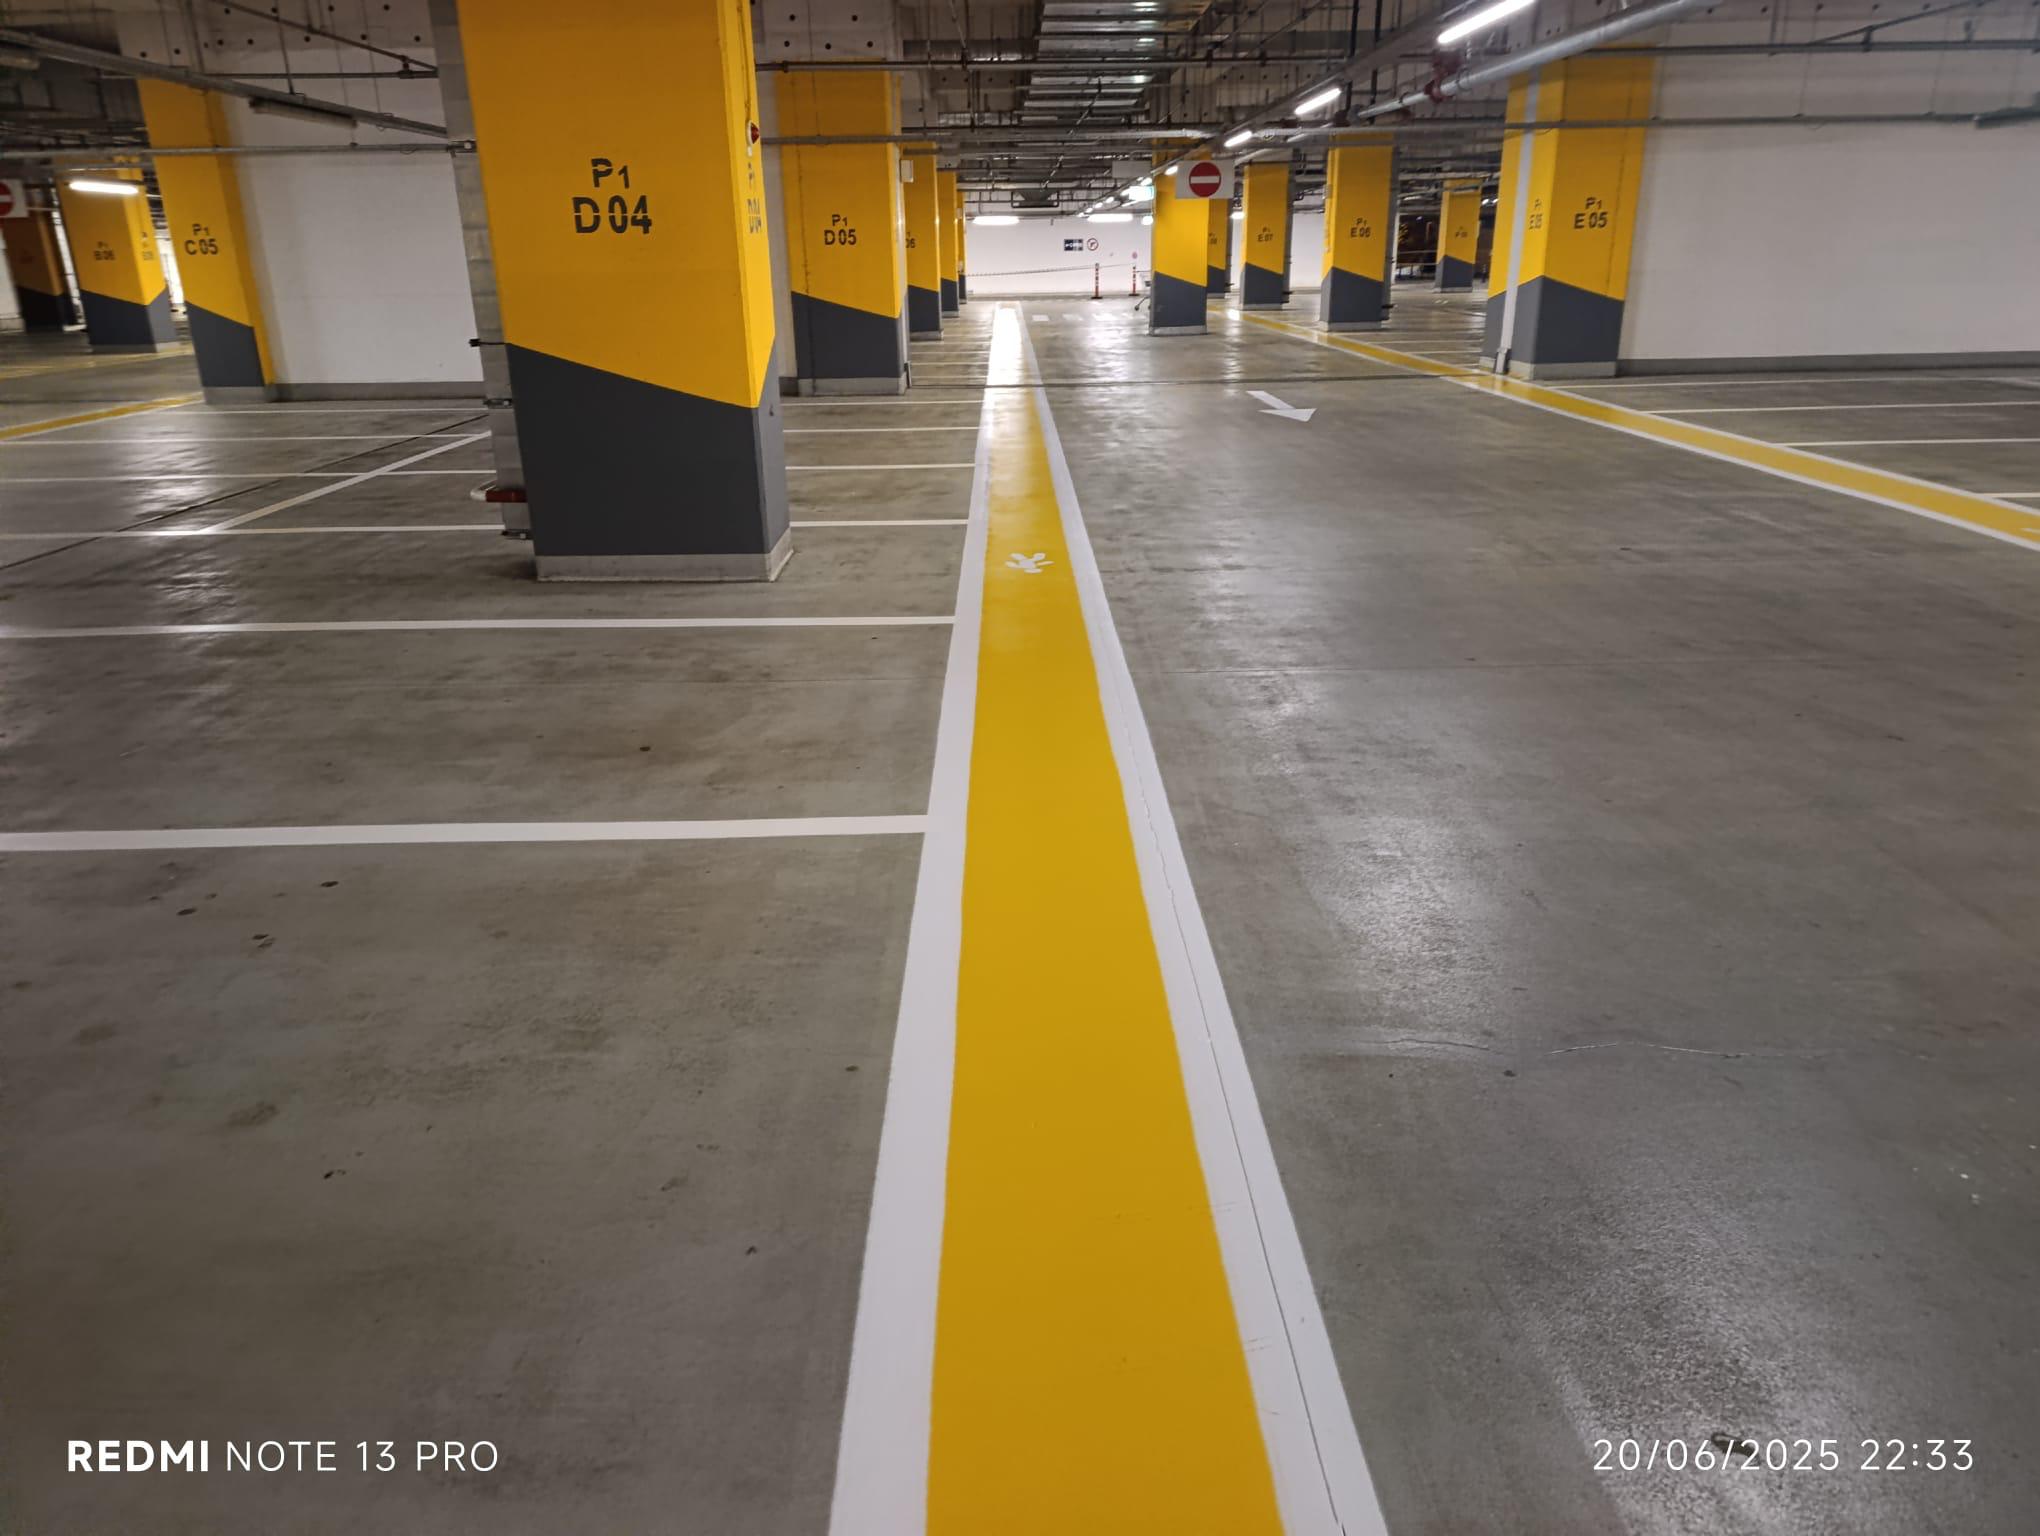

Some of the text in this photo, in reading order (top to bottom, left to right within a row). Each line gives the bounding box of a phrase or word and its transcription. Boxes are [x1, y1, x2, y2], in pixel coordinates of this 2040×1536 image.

[591, 158, 630, 189] P1
[1585, 197, 1602, 210] P1
[831, 214, 848, 226] P1
[192, 223, 209, 236] P1
